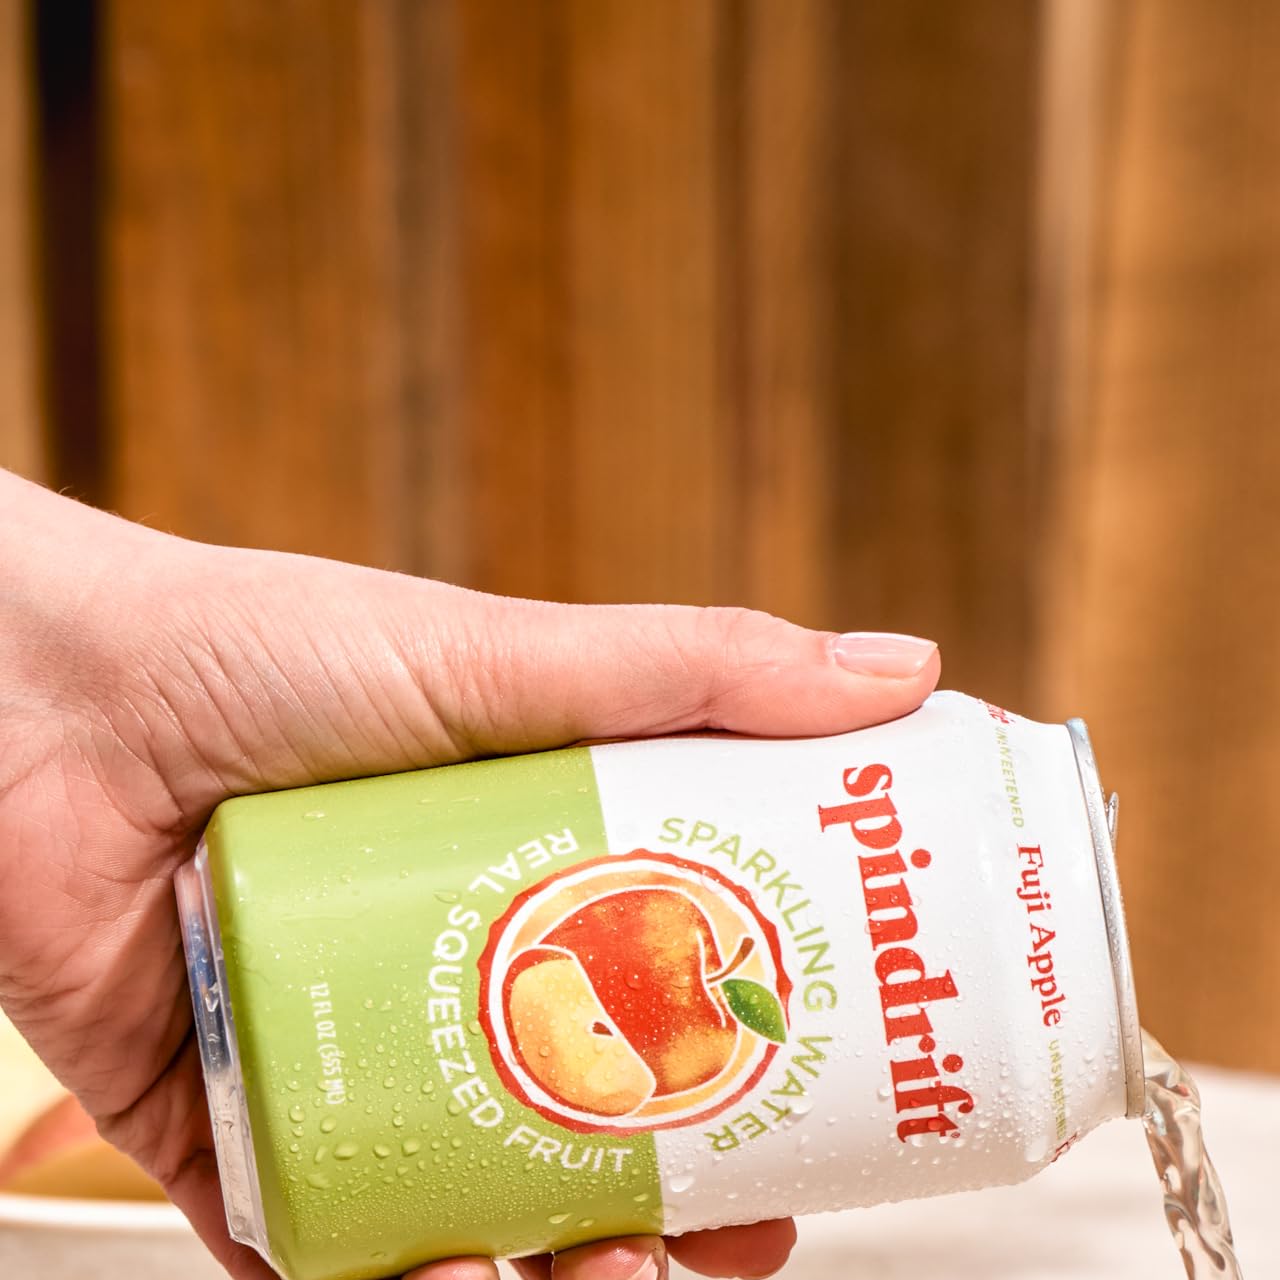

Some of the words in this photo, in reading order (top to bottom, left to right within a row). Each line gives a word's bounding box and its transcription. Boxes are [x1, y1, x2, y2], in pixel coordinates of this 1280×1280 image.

[468, 828, 580, 894] REAL
[1016, 843, 1052, 915] Fuji
[658, 817, 838, 1013] SPARKLING
[817, 763, 974, 1143] spindrift
[1028, 923, 1067, 1027] Apple
[310, 982, 330, 999] 12
[313, 1001, 333, 1018] FL
[428, 904, 505, 1129] SQUEEZED
[315, 1020, 336, 1040] OZ
[317, 1043, 342, 1076] (355
[704, 1036, 833, 1153] WATER
[503, 1125, 634, 1173] FRUIT
